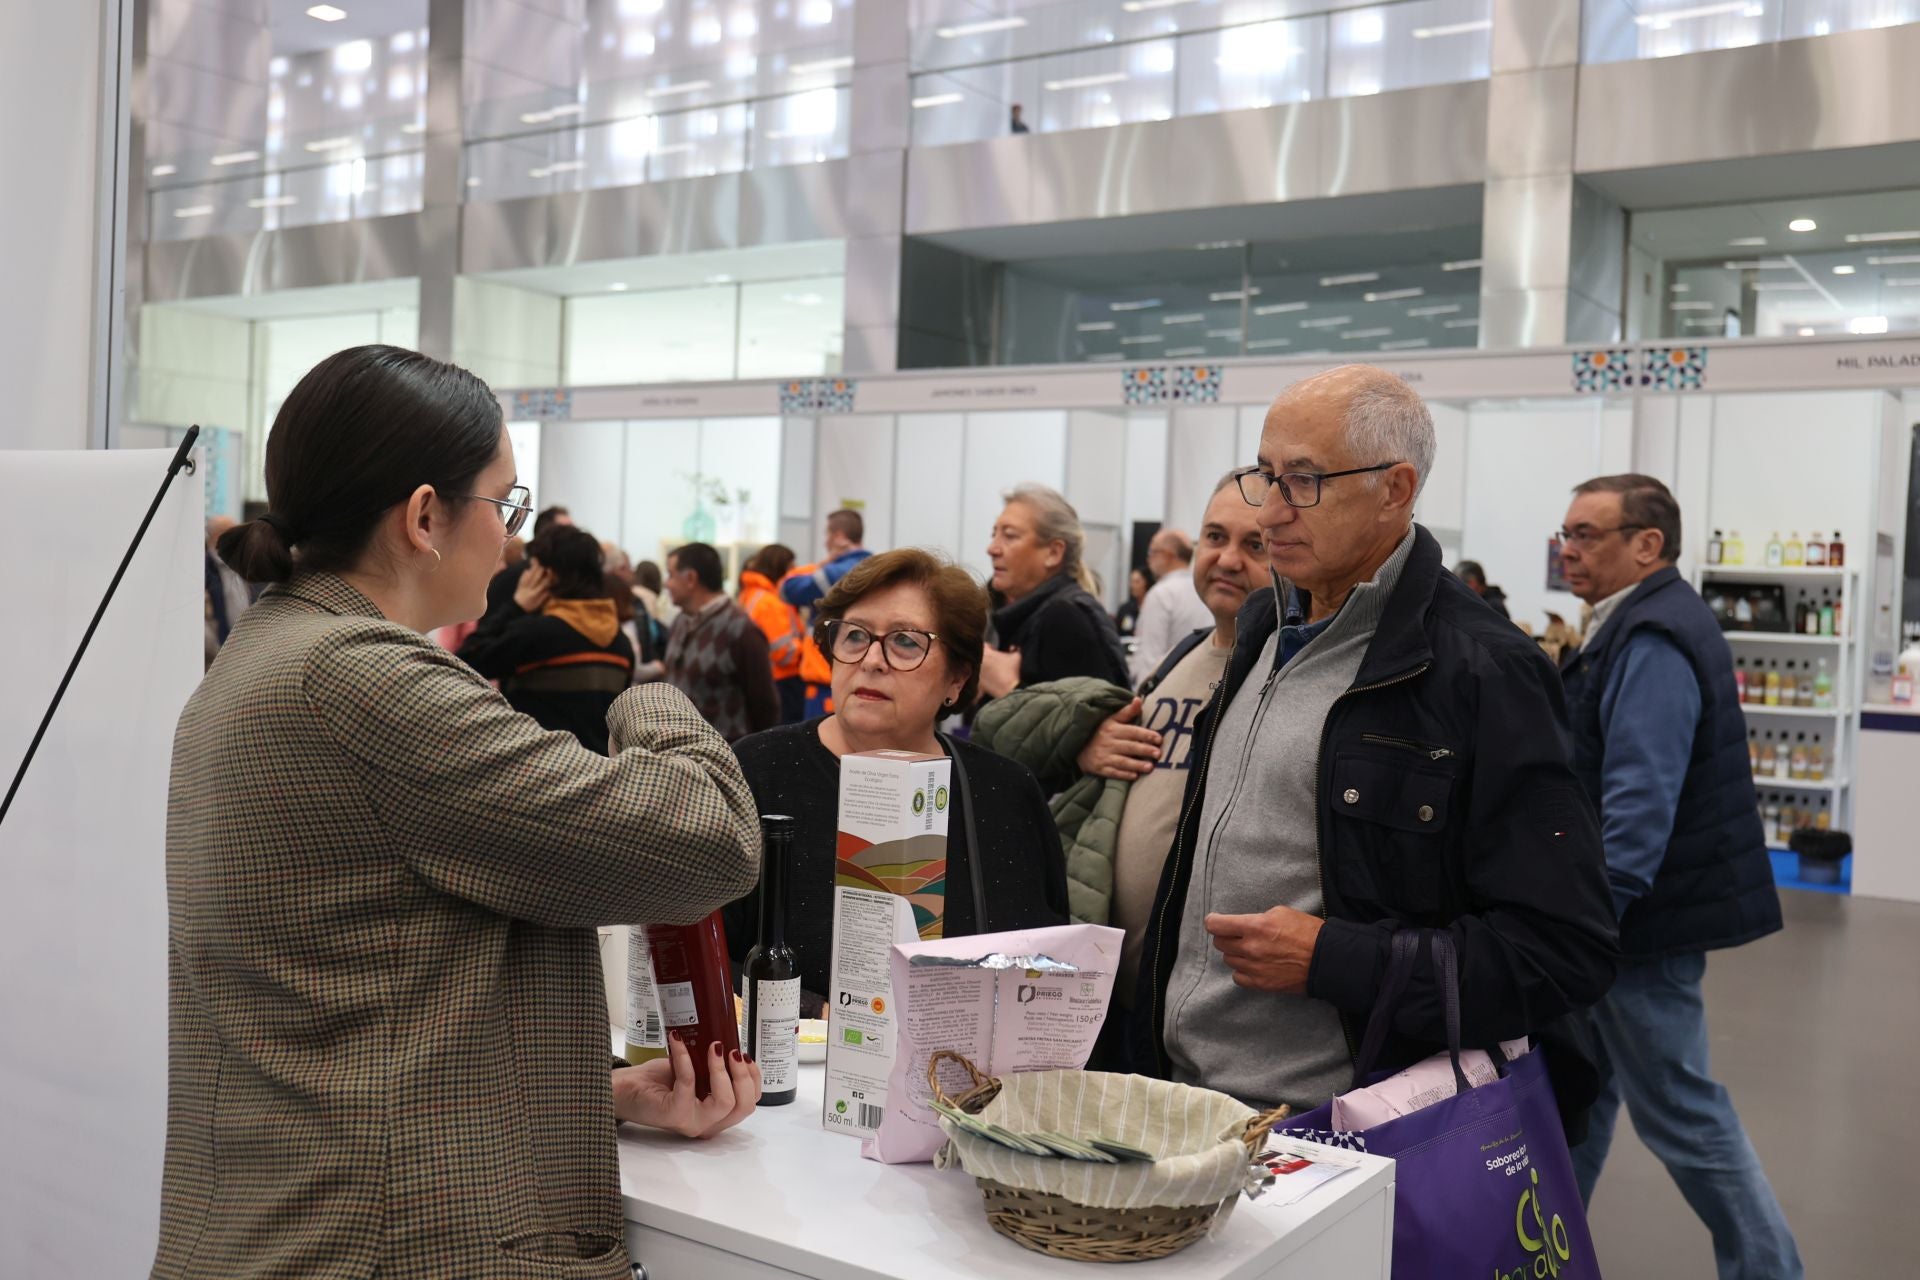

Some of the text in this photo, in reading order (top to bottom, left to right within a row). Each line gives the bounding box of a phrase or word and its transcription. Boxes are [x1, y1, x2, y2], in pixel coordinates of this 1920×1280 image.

[1836, 357, 1862, 369] MIL
[828, 1113, 853, 1127] 500 ml
[1505, 1165, 1516, 1176] de
